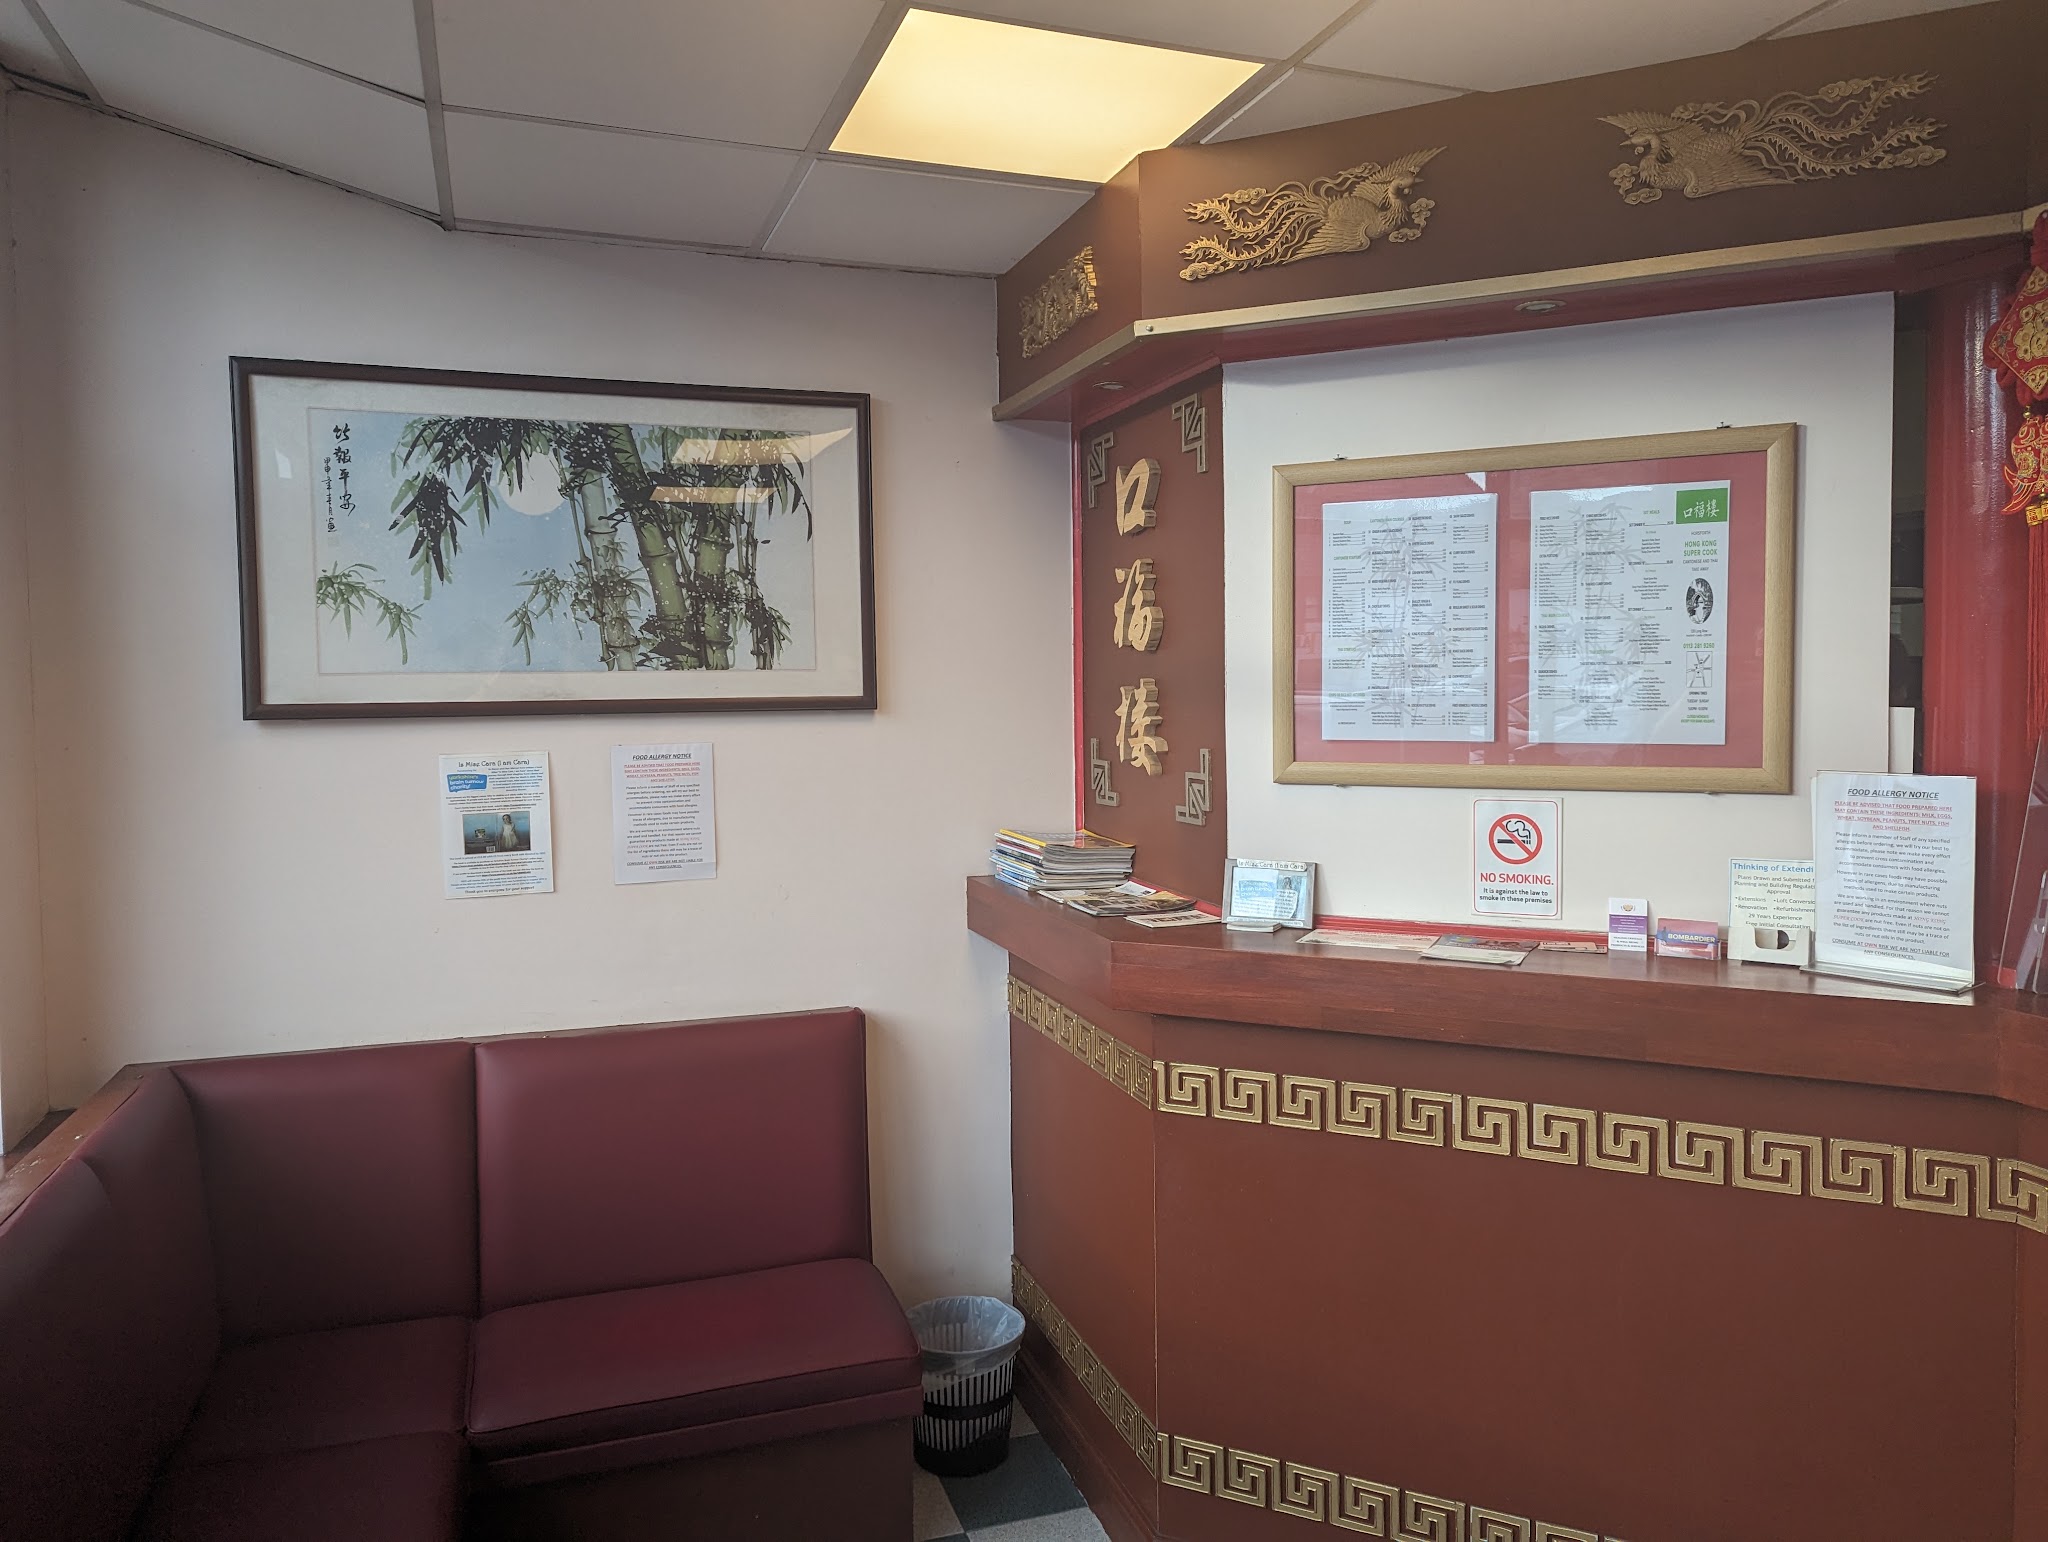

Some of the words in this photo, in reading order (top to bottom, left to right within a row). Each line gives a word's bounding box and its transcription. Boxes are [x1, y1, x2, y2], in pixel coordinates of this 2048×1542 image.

[1683, 499, 1719, 518] 口福樓
[1684, 549, 1701, 557] SUPER
[1848, 788, 1870, 796] FOOD
[1872, 789, 1907, 798] ALLERGY
[1908, 791, 1939, 799] NOTICE
[1873, 841, 1894, 849] ordering,
[1834, 846, 1869, 854] accommodate,
[1733, 863, 1768, 872] Thinking
[1839, 860, 1872, 868] accommodate
[1480, 873, 1496, 882] NO
[1499, 873, 1554, 885] SMOKING.
[1495, 888, 1517, 896] against
[1916, 891, 1939, 899] products.
[1668, 933, 1716, 942] BOMBARDIER
[1832, 938, 1856, 946] CONSUME
[1864, 941, 1877, 949] OWN
[1899, 945, 1909, 953] ARE
[1922, 948, 1938, 956] LIABLE
[1874, 950, 1916, 961] CONSEQUENCES.
